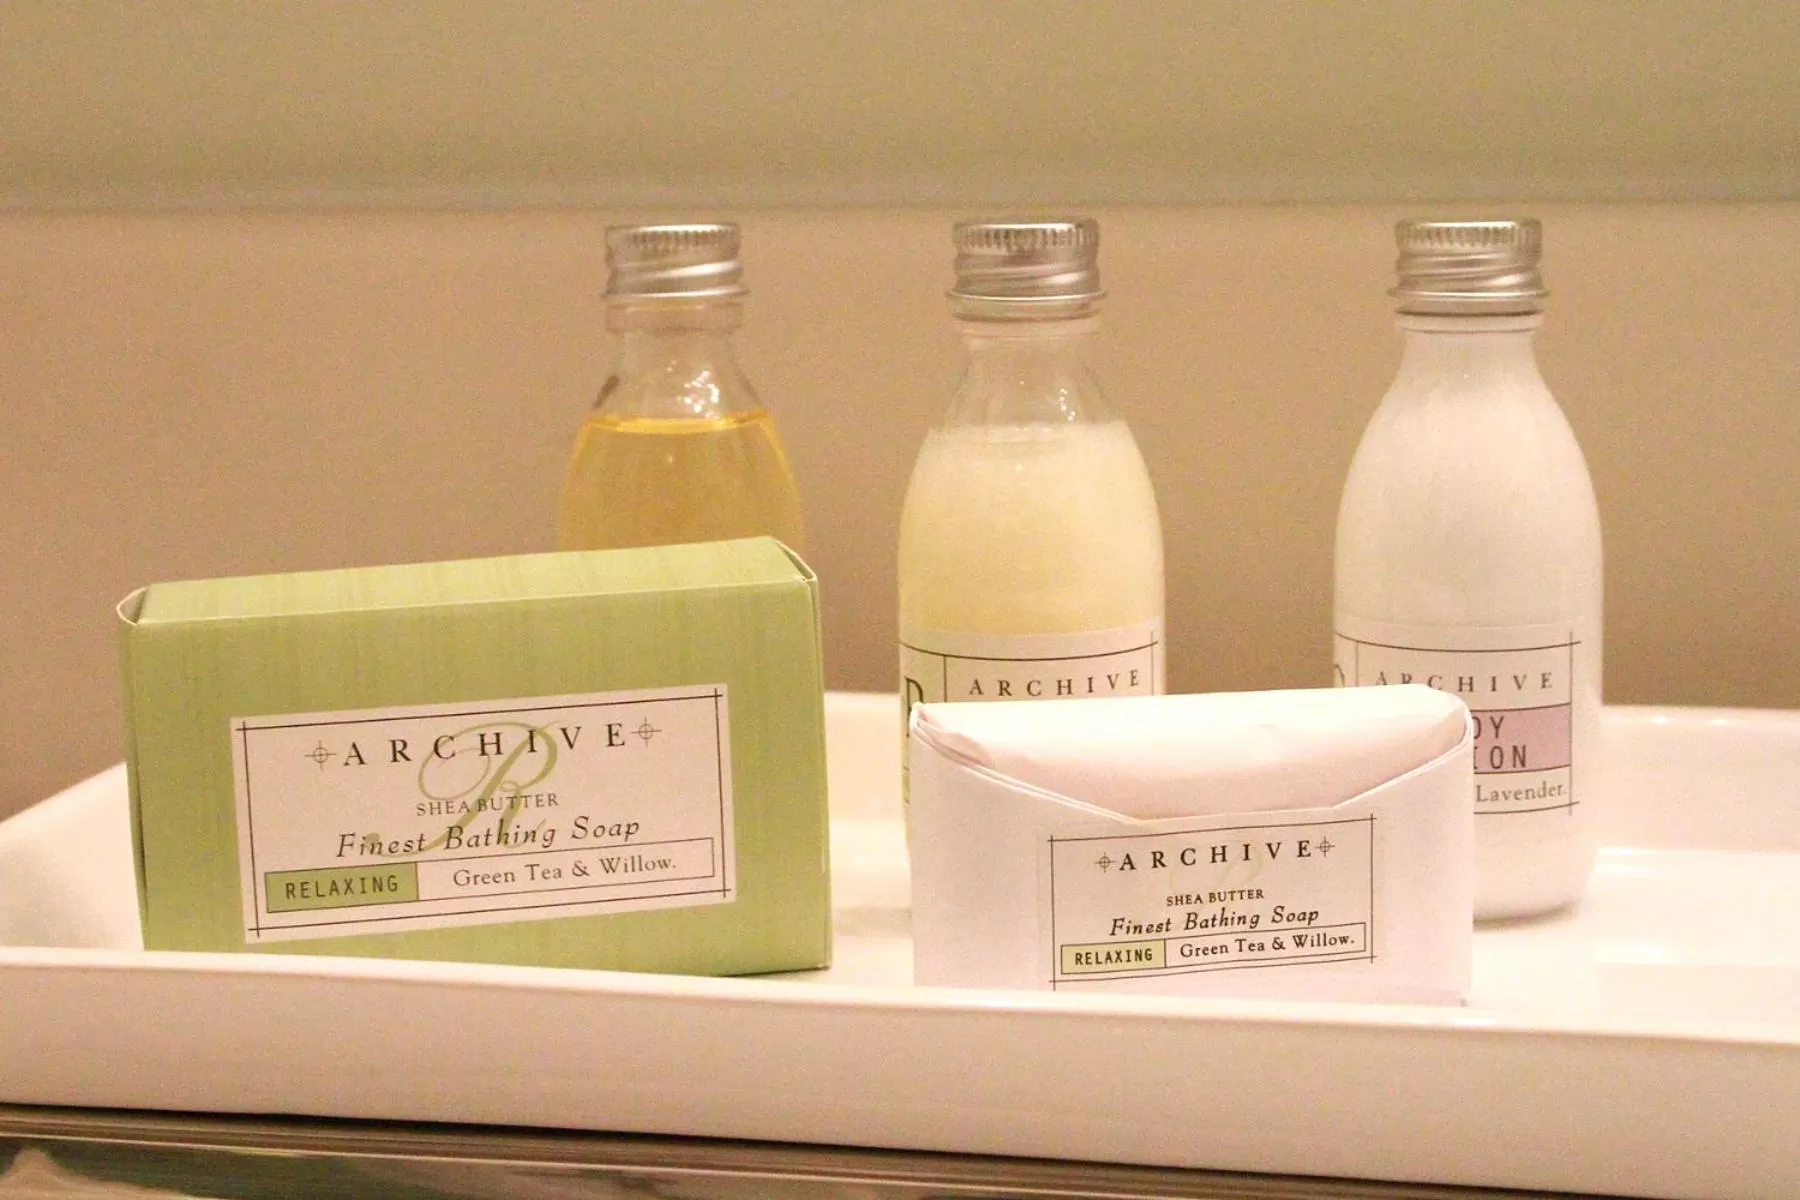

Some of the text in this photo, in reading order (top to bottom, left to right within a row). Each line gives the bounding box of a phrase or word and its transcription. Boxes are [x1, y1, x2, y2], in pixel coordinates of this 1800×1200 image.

[969, 669, 1140, 697] ARCHIVE
[343, 722, 626, 767] ARCHIVE
[416, 793, 559, 817] SHEA BUTTER
[1475, 780, 1567, 802] Lavender.
[336, 815, 641, 858] Finest Bathing Soap
[1118, 839, 1312, 871] ARCHIVE
[285, 853, 677, 901] RELAXING Green Tea & Willow.
[1166, 888, 1265, 907] SHEA BUTTER
[1109, 905, 1319, 937] Finest Bathing Soap
[1074, 931, 1356, 967] RELAXING Green Tea & Willow.
